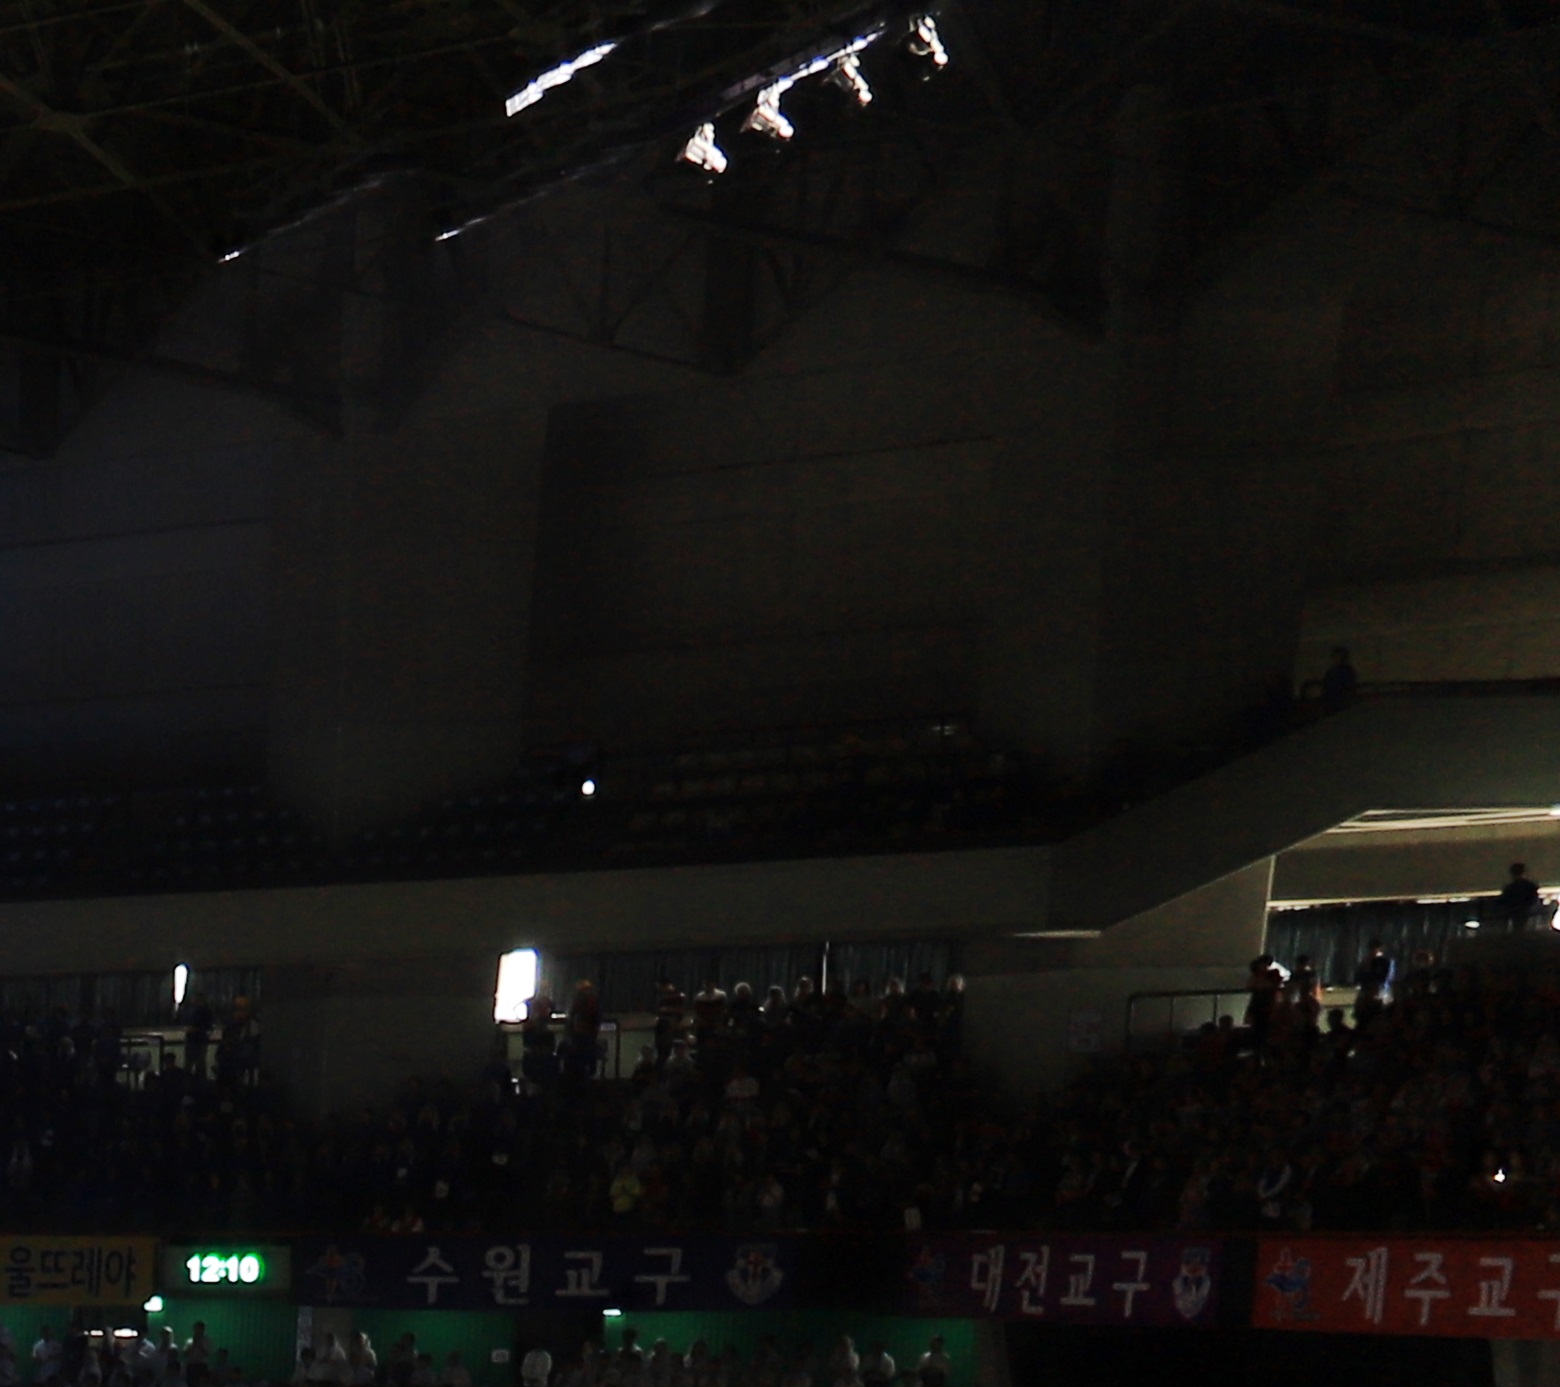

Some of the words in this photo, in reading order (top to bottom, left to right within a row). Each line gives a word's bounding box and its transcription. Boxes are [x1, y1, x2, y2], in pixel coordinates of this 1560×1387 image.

[3, 1245, 134, 1299] 울뜨레야
[186, 1253, 261, 1283] 12:10
[406, 1243, 691, 1306] 수원교구
[970, 1244, 1151, 1318] 대전교구
